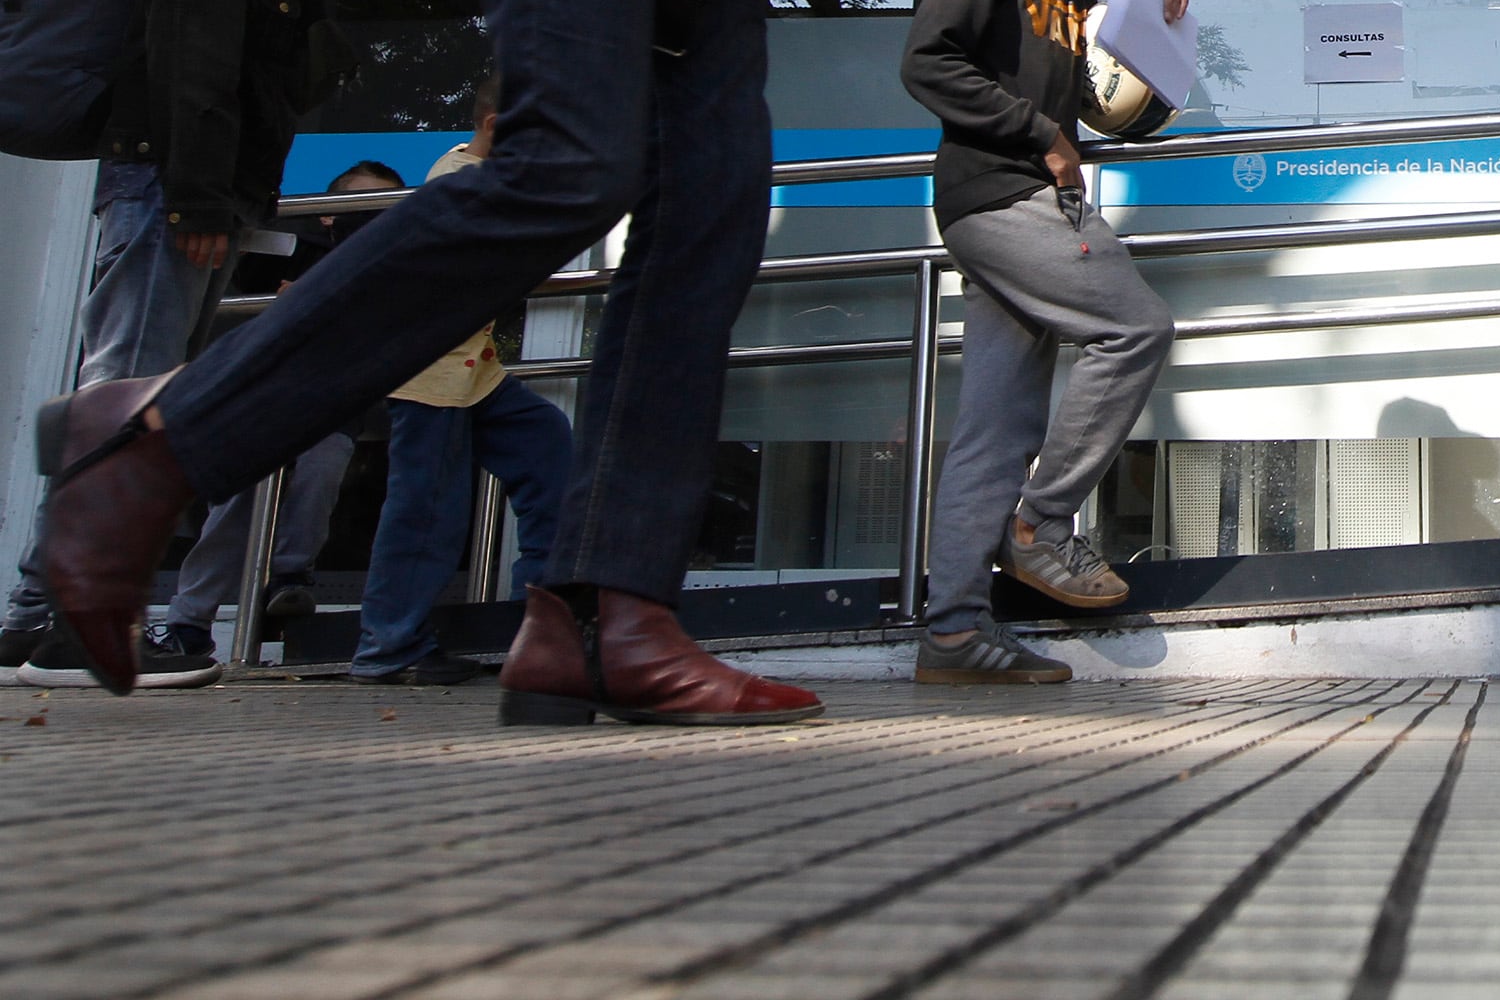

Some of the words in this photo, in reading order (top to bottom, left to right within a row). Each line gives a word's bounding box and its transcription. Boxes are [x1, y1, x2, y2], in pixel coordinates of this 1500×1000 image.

[1320, 33, 1385, 43] CONSULTAS
[1276, 159, 1390, 176] Presidencia
[1396, 158, 1421, 174] de
[1427, 158, 1444, 174] la
